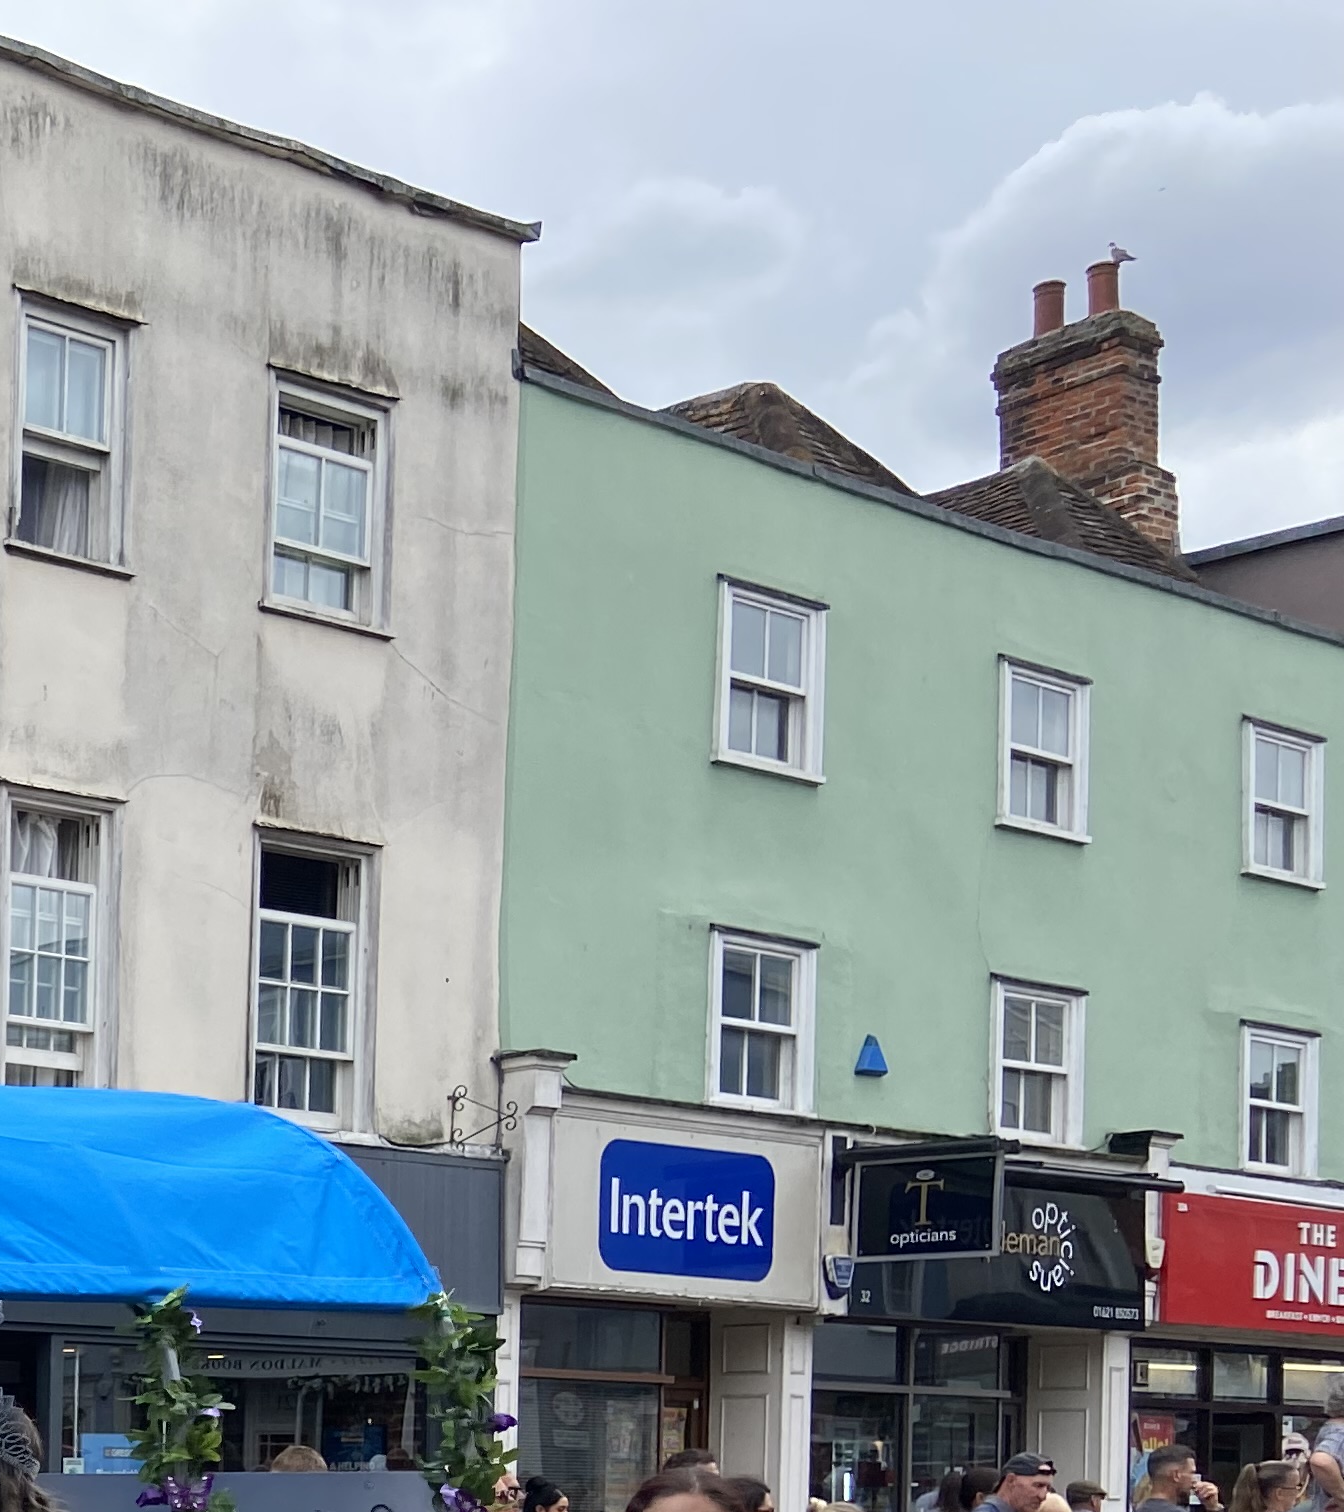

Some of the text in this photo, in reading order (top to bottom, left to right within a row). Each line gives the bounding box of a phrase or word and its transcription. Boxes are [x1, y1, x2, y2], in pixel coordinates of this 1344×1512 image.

[610, 1176, 764, 1247] Intertek
[889, 1228, 958, 1249] opticians
[1297, 1221, 1337, 1248] THE
[861, 1290, 871, 1303] 32
